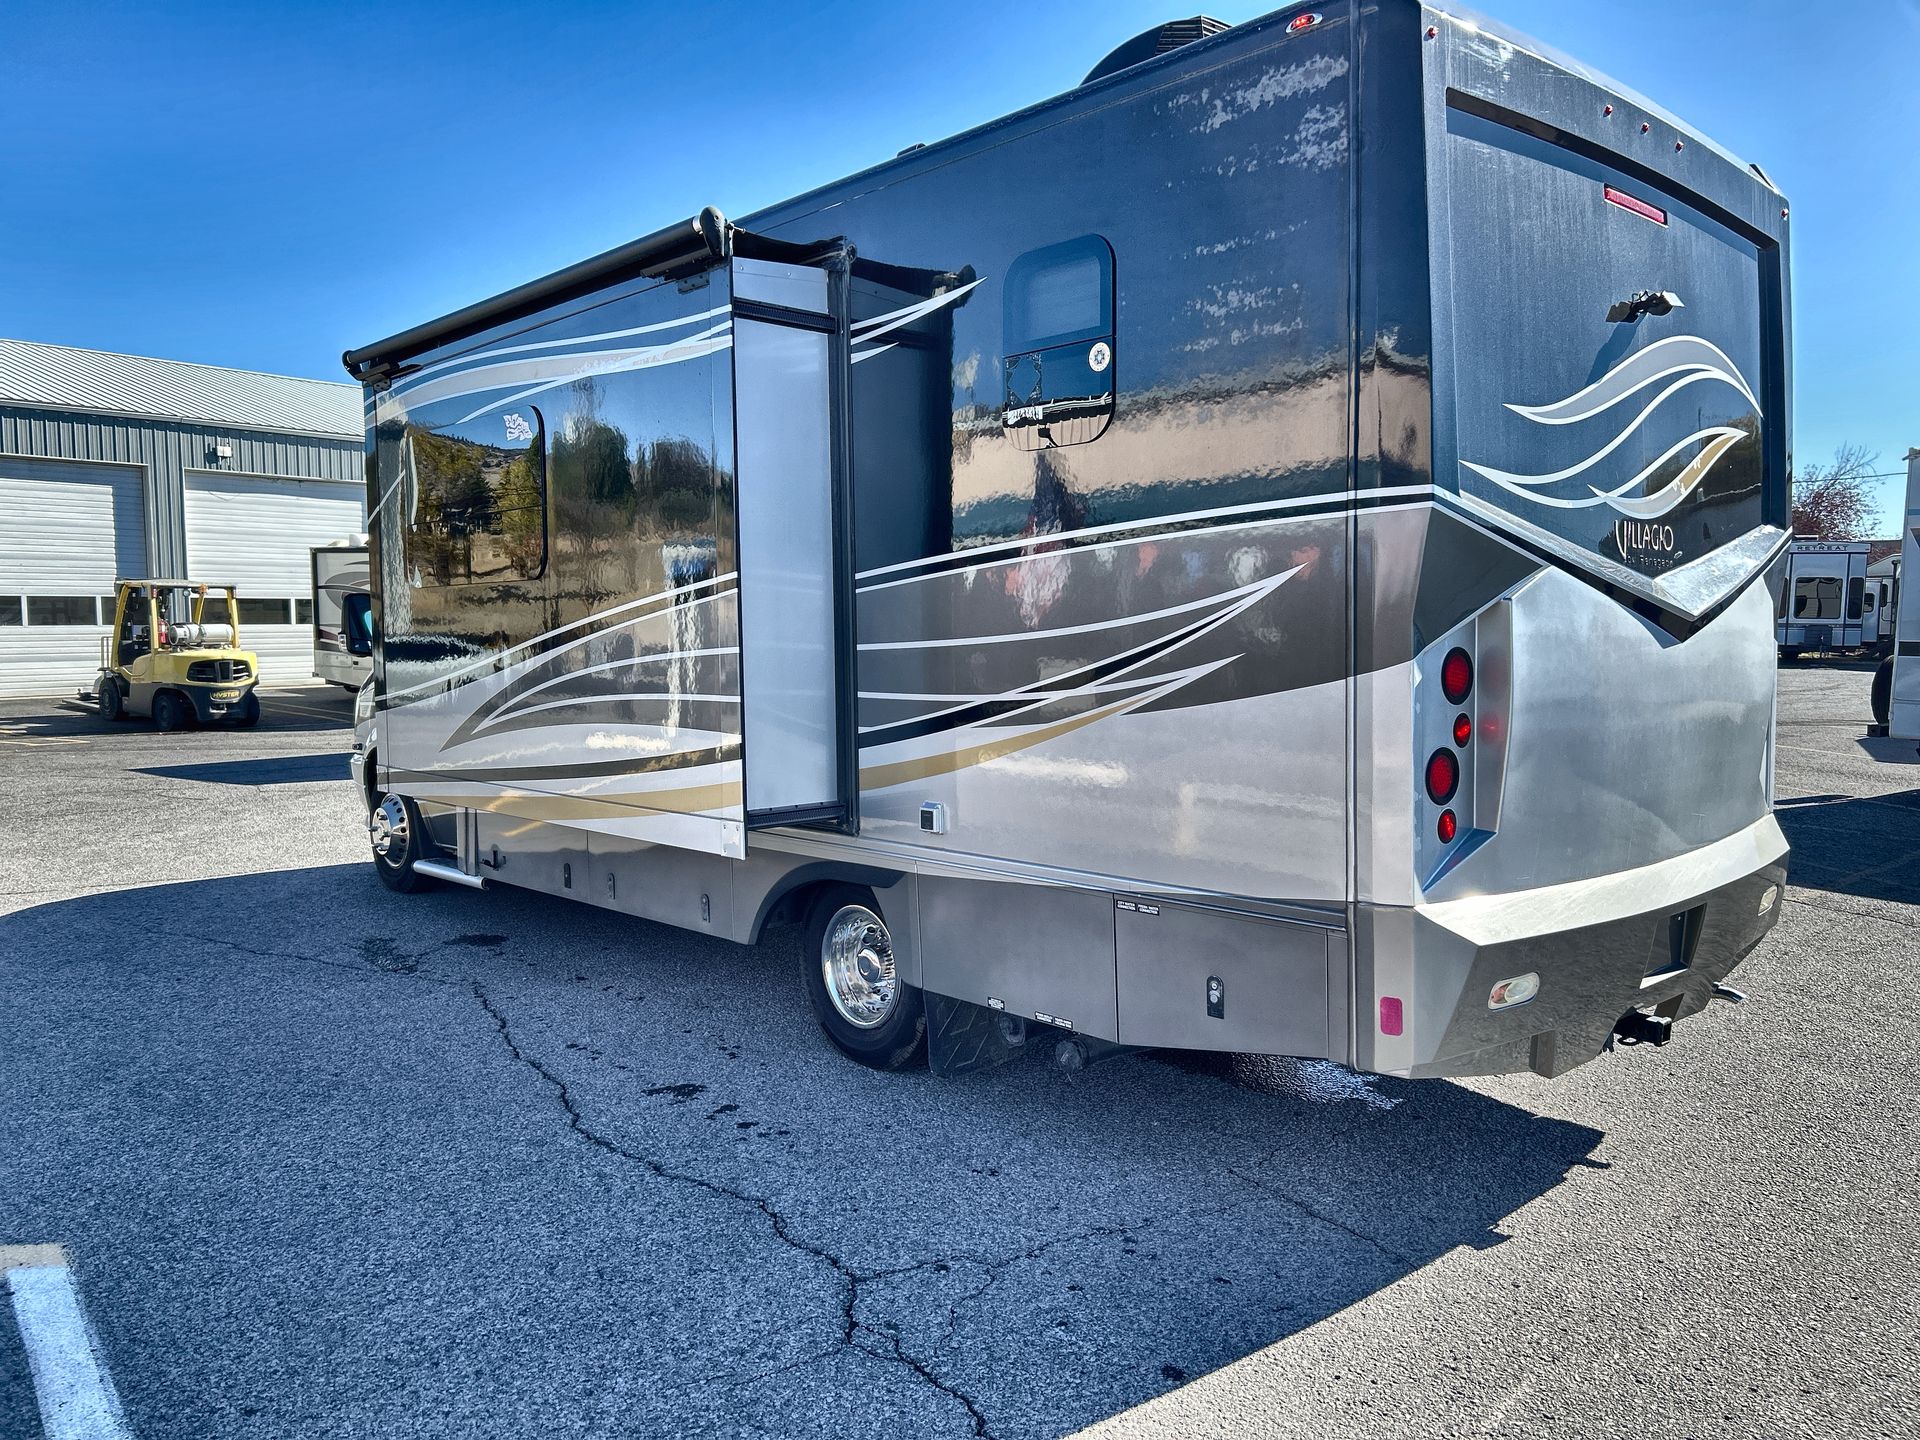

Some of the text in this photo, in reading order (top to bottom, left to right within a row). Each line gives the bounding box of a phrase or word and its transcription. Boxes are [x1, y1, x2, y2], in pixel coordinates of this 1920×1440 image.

[1614, 520, 1674, 562] VILLAGIO
[1796, 544, 1849, 552] RETREAT
[213, 690, 240, 699] HYSTER
